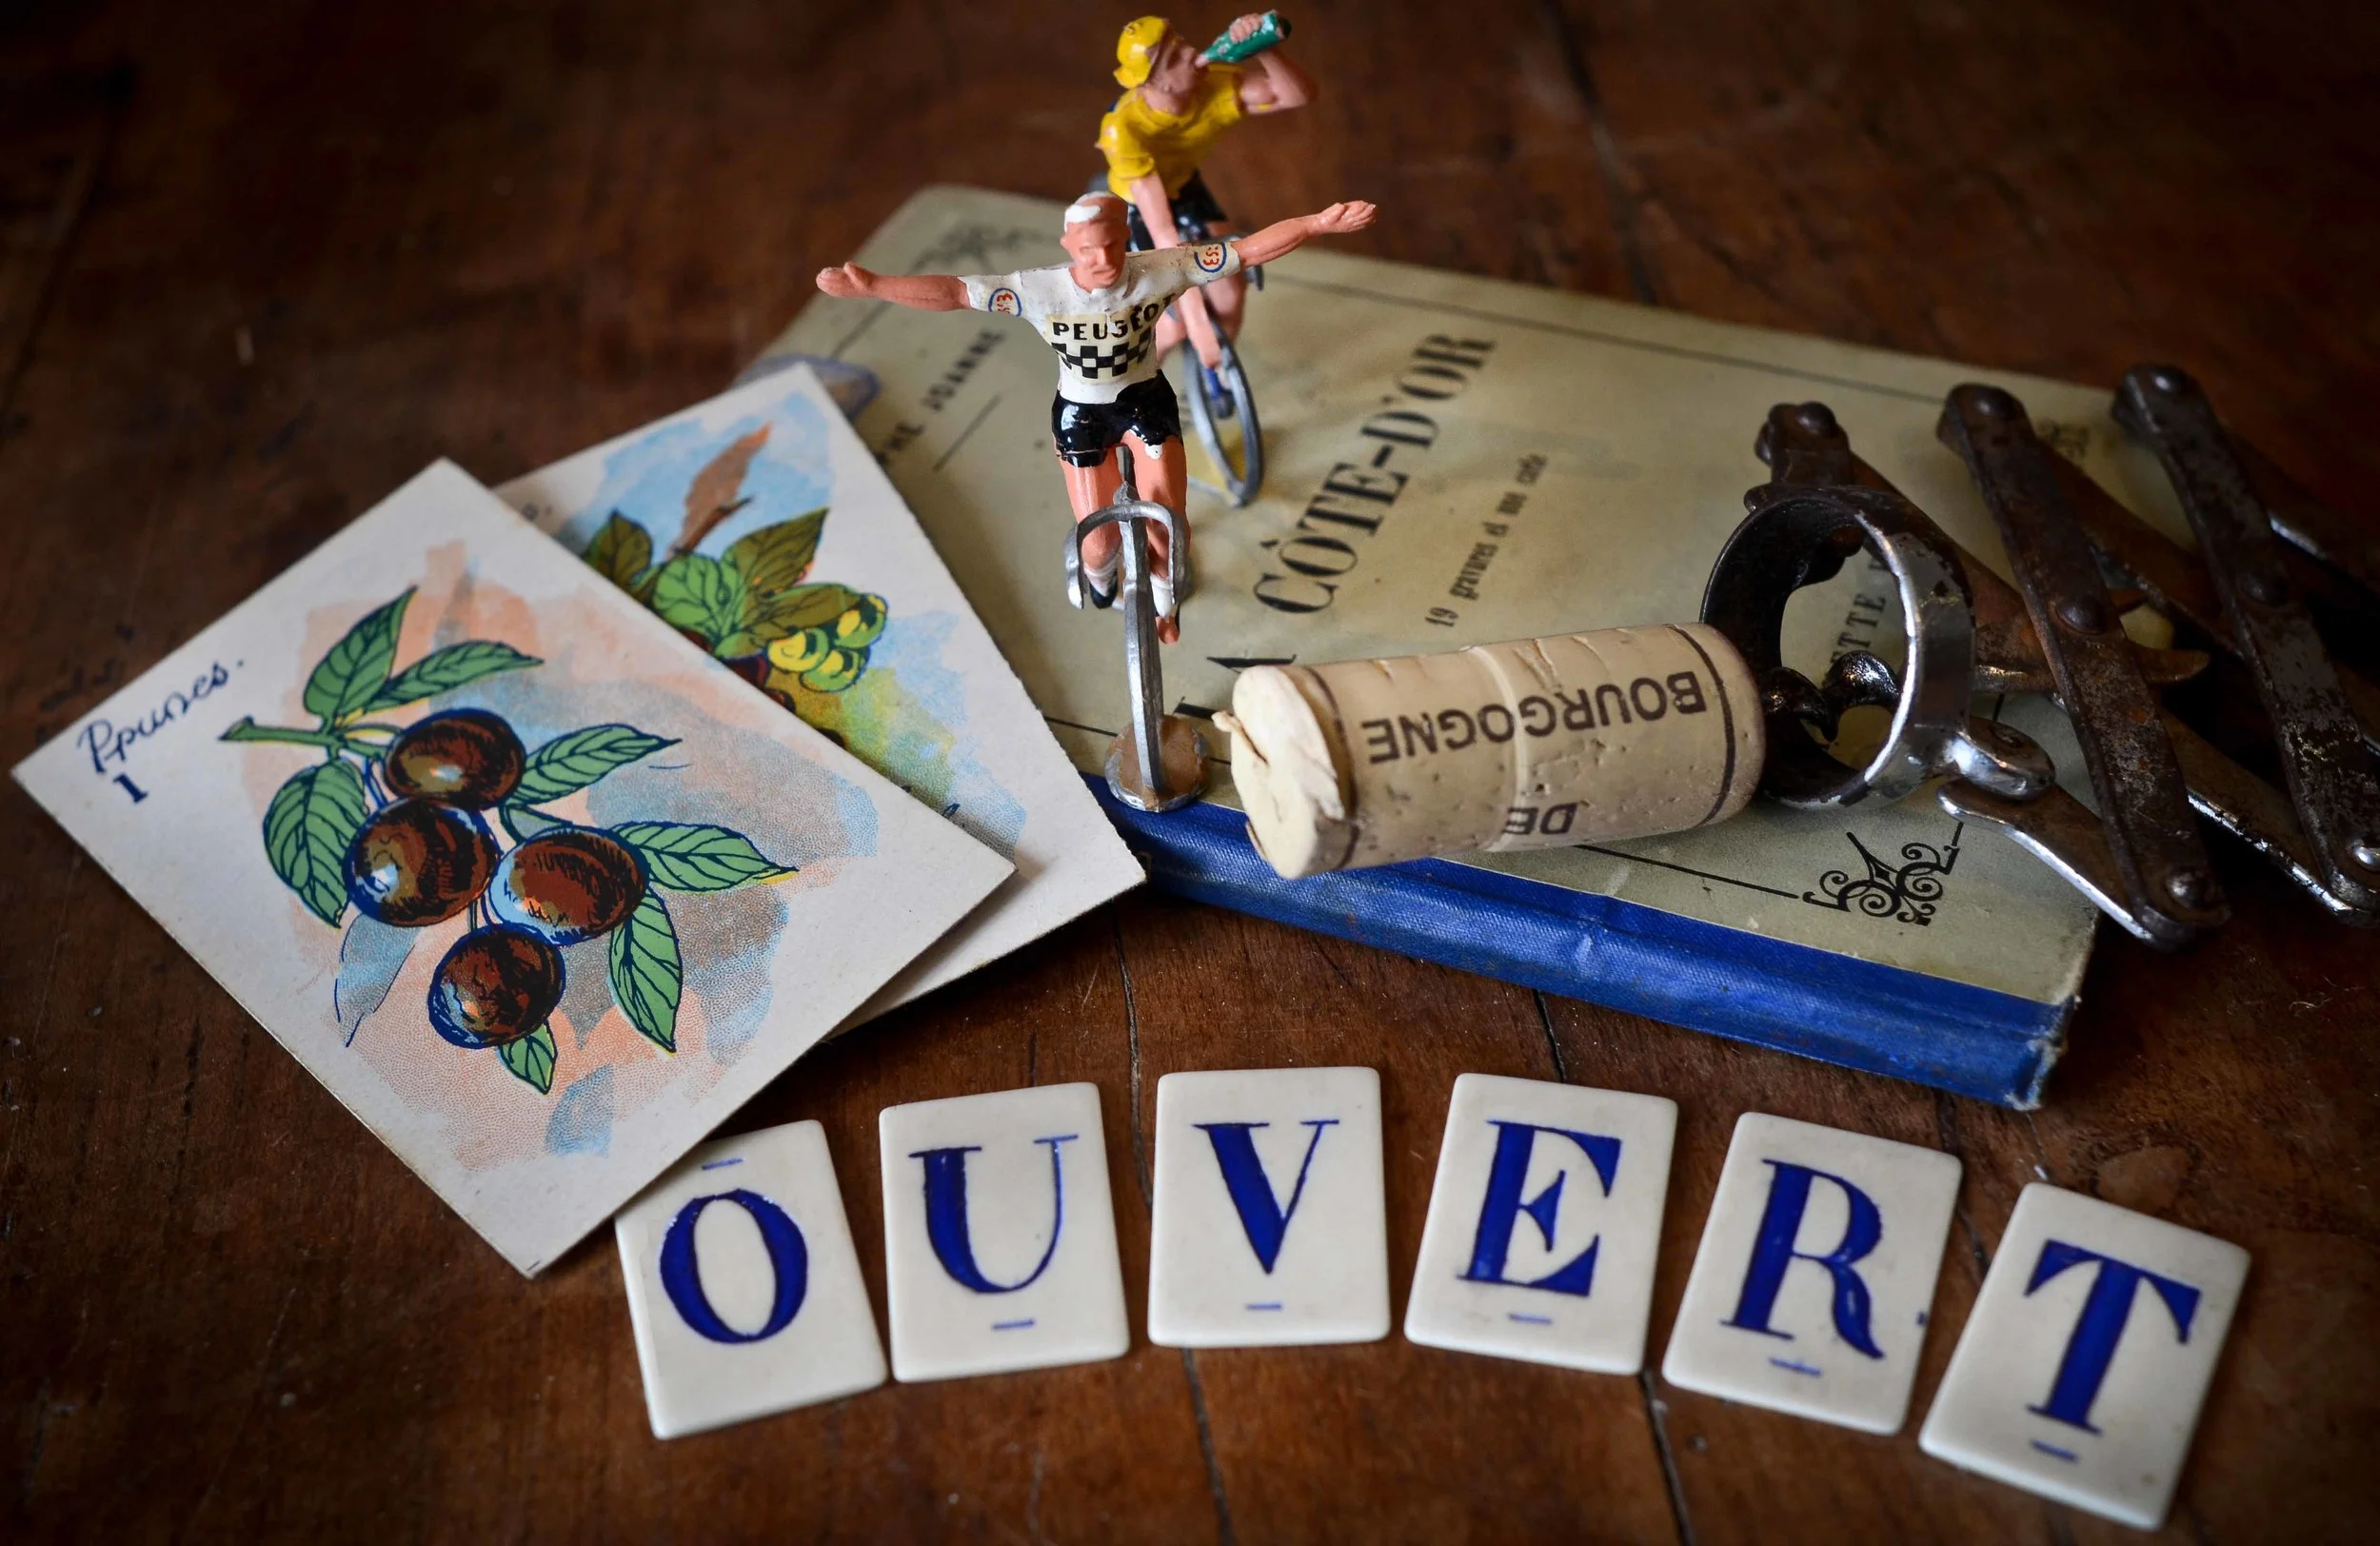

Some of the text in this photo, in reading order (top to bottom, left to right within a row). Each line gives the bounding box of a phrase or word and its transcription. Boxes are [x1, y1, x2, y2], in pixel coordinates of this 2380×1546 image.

[1424, 605, 1459, 628] 19
[1361, 670, 1707, 763] BOURGOGNE
[1502, 803, 1577, 836] DE
[659, 1118, 2203, 1437] OUVERT
